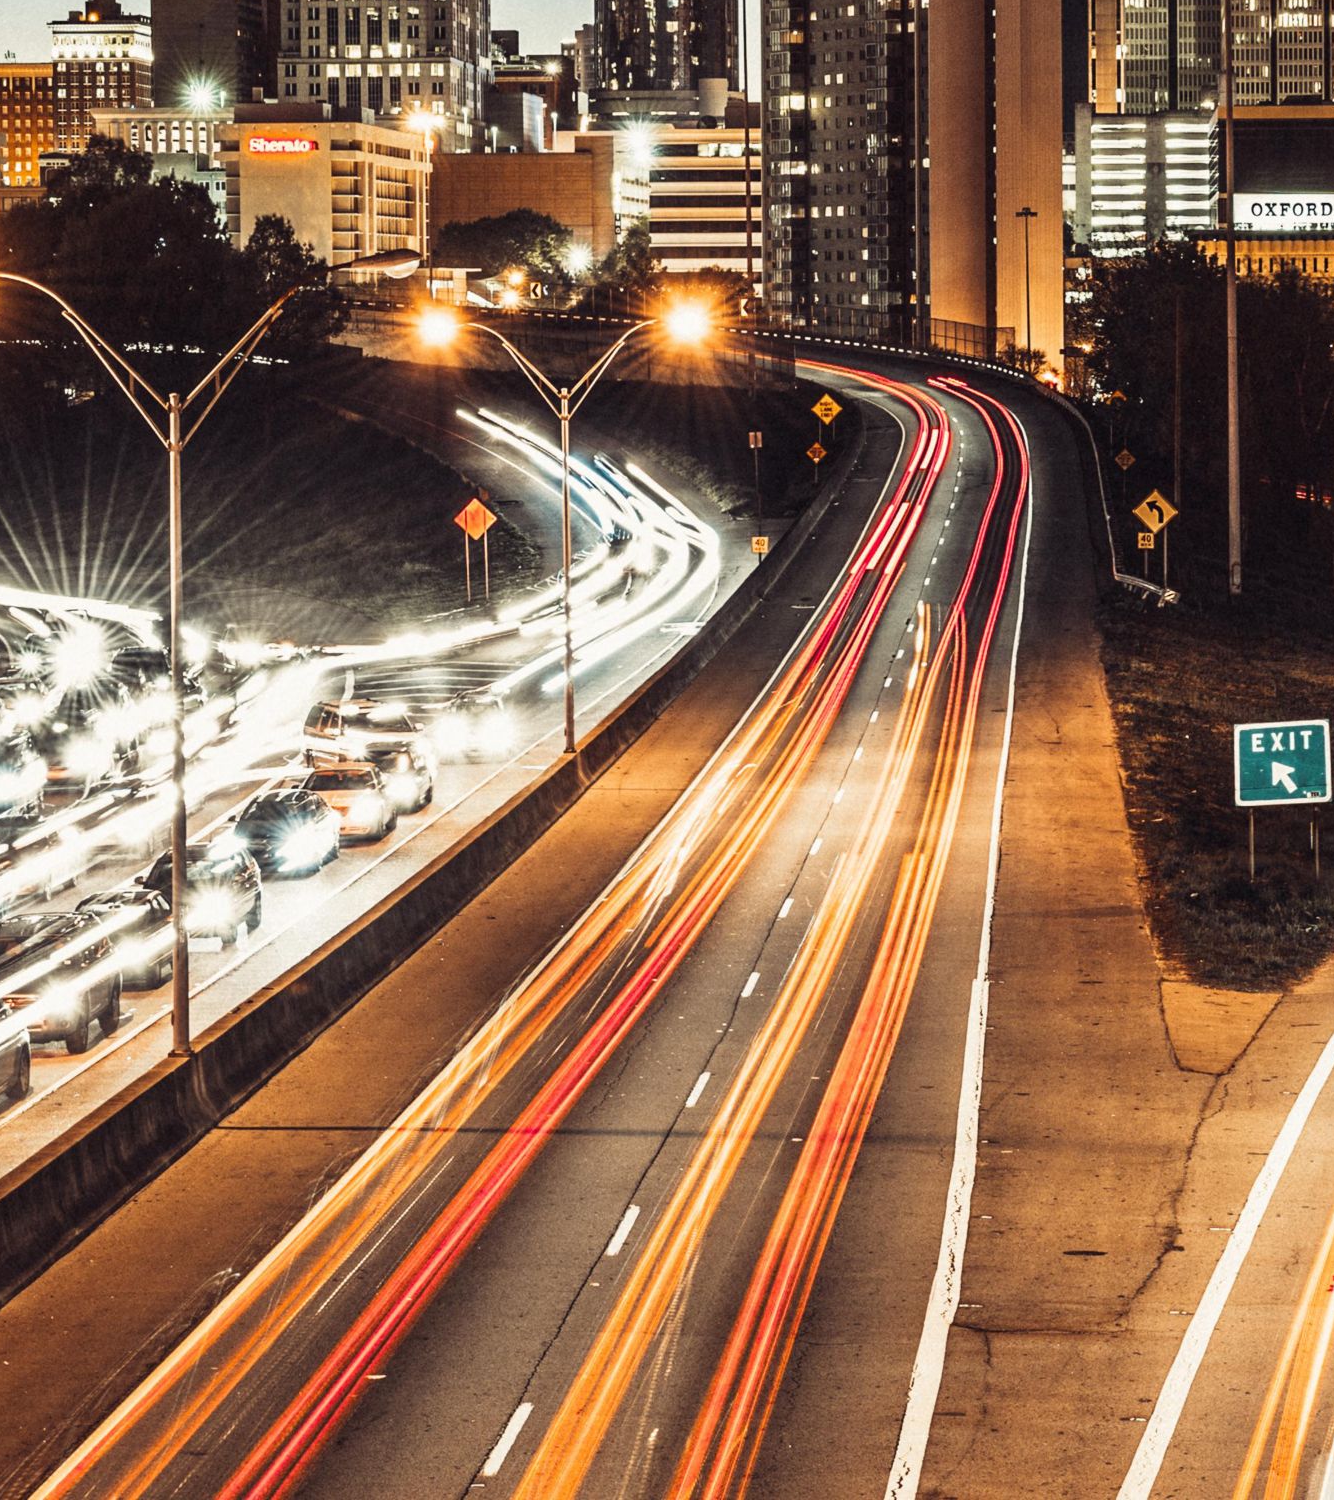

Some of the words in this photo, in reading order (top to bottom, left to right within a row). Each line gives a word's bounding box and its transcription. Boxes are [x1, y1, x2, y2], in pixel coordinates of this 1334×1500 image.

[249, 137, 319, 152] Sheraton
[1251, 202, 1333, 217] OXFORD
[754, 538, 765, 547] 40
[1140, 534, 1152, 543] 40
[1251, 730, 1313, 753] EXIT
